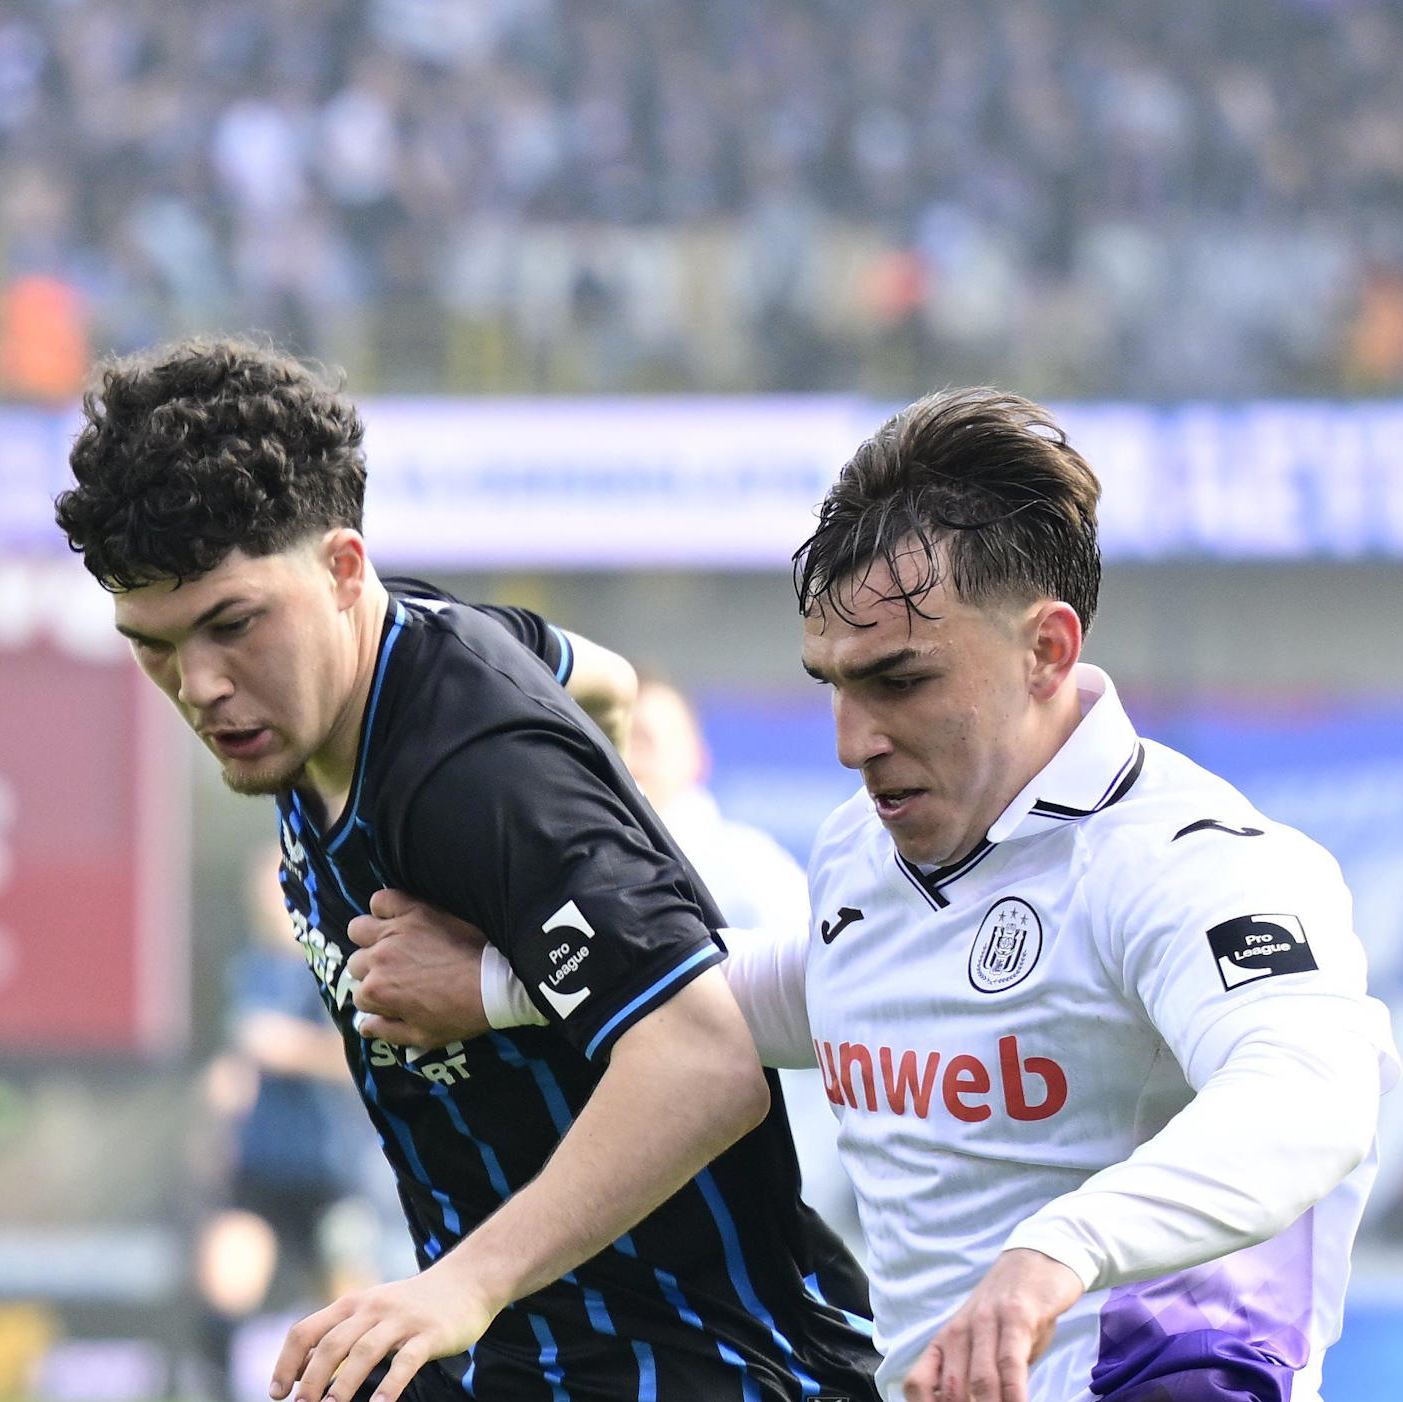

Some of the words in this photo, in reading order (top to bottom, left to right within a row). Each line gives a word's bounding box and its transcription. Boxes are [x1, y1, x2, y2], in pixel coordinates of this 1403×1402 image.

[1245, 934, 1273, 945] Pro
[549, 943, 570, 965] Pro
[1234, 943, 1291, 960] League
[548, 946, 589, 986] League
